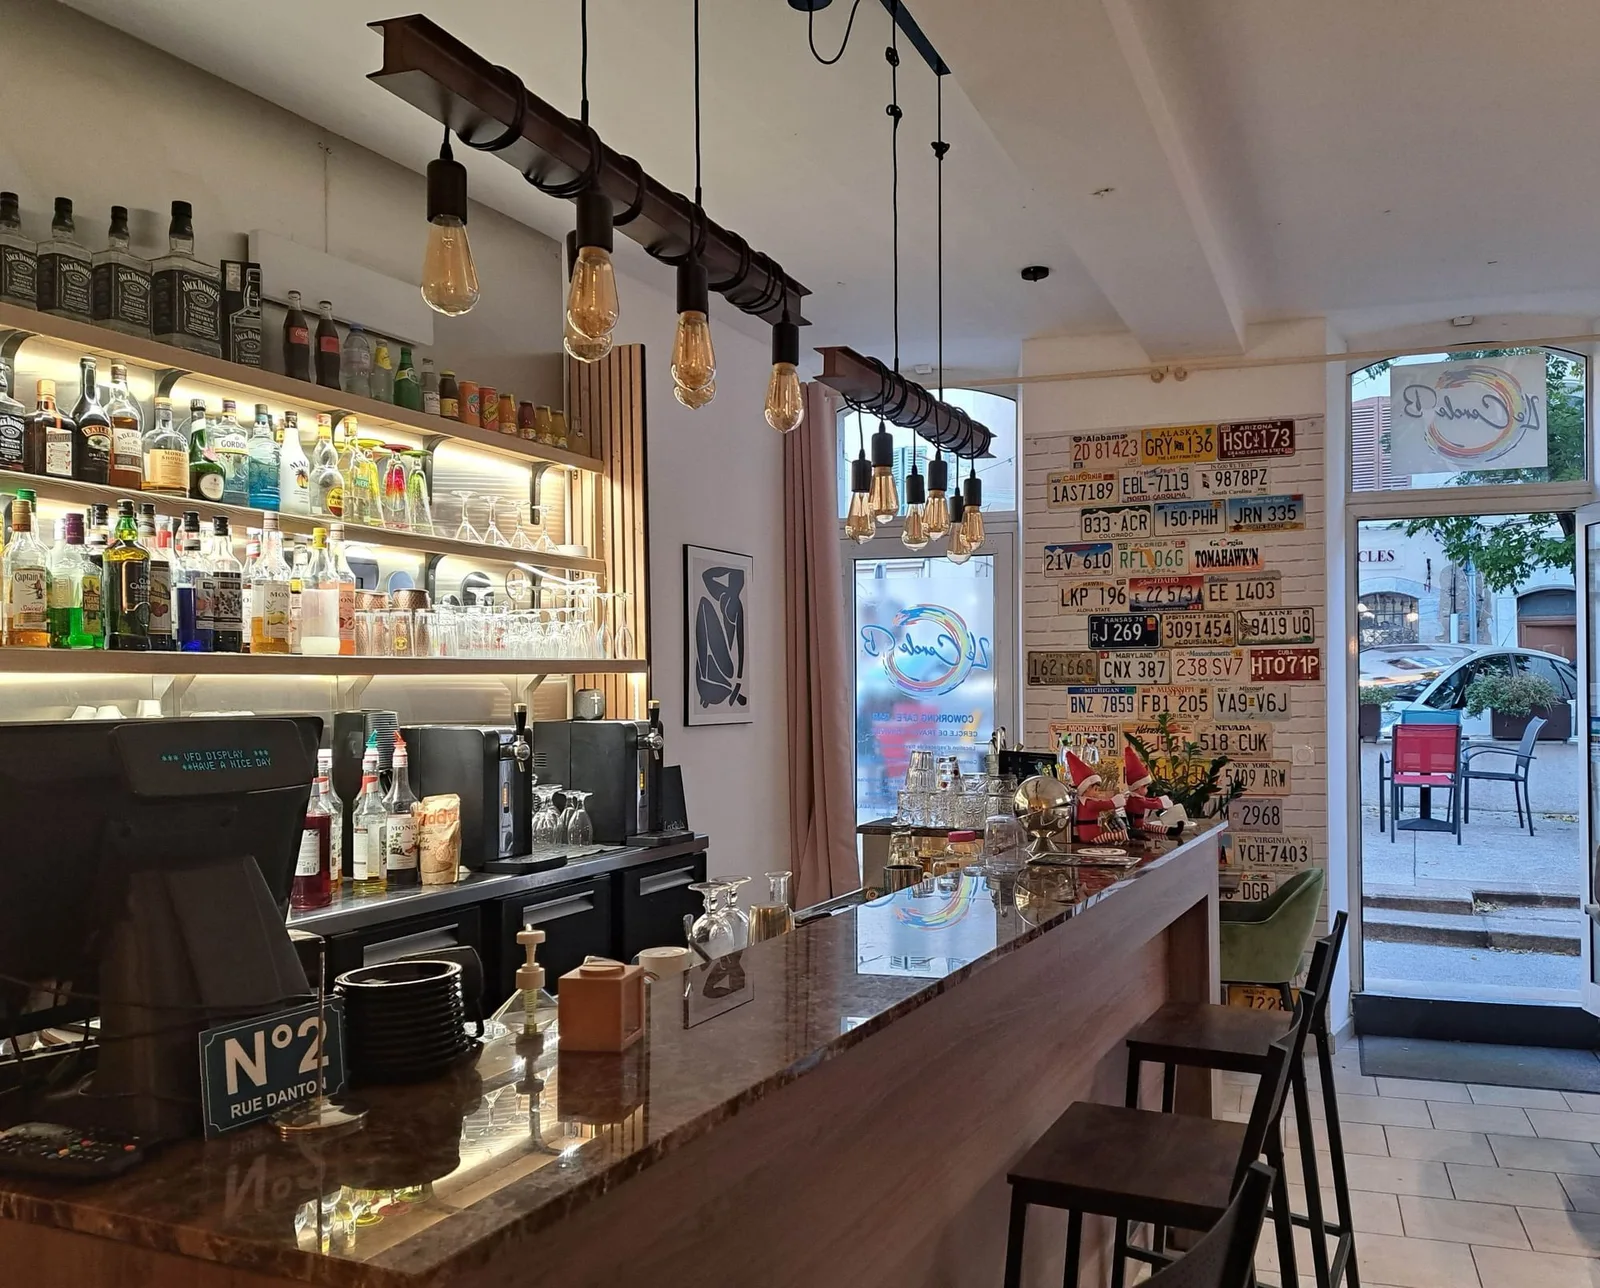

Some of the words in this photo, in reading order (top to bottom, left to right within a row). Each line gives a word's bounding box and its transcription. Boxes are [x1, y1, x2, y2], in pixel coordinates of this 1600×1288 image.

[182, 280, 197, 292] JACK
[1160, 428, 1199, 438] ALASKA
[1239, 423, 1273, 431] ARIZONA
[1085, 433, 1127, 443] Alabama
[1145, 437, 1173, 456] GRY
[1187, 434, 1213, 454] 136
[1223, 431, 1253, 451] HSC
[1260, 428, 1290, 449] 173
[1073, 443, 1091, 461] 2D
[1095, 439, 1138, 460] 81423
[1063, 472, 1102, 482] CALIFORNIA
[1122, 472, 1189, 495] EBL-7119
[1215, 468, 1267, 487] 9878PZ
[1052, 482, 1114, 503] 1AS7189
[1153, 492, 1186, 501] CAROLINA
[1233, 506, 1263, 524] JRN
[1267, 503, 1297, 522] 335
[1209, 538, 1244, 548] Georgia
[1045, 553, 1073, 571] 21V
[1083, 552, 1111, 569] 610
[1120, 551, 1149, 569] RFL
[1194, 547, 1259, 568] TOMAHAWK'N
[14, 571, 39, 583] Captain
[1061, 587, 1088, 607] LKP
[1099, 586, 1127, 606] 196
[1146, 586, 1163, 603] 22
[1167, 584, 1193, 603] 573
[1209, 583, 1229, 602] EE
[1235, 581, 1275, 601] 1403
[1113, 623, 1143, 642] 269
[1251, 616, 1287, 636] 9419
[1104, 660, 1131, 679] CNX
[1138, 660, 1166, 679] 387
[1176, 658, 1207, 677] 238
[1212, 657, 1243, 676] SV7
[1070, 696, 1094, 714] BNZ
[1102, 695, 1134, 713] 7859
[1141, 695, 1170, 713] FB1
[1178, 695, 1208, 713] 205
[1217, 693, 1248, 713] YA9
[1256, 692, 1287, 713] V6J
[1069, 725, 1105, 733] MONTANA
[183, 752, 202, 762] VFD
[206, 750, 243, 761] DISPLAY
[230, 758, 253, 769] NICE
[256, 757, 271, 767] DAY
[1263, 769, 1286, 788] ARW
[1242, 805, 1280, 826] 2968
[1253, 836, 1291, 844] VIRGINIA
[230, 1097, 263, 1120] RUE
